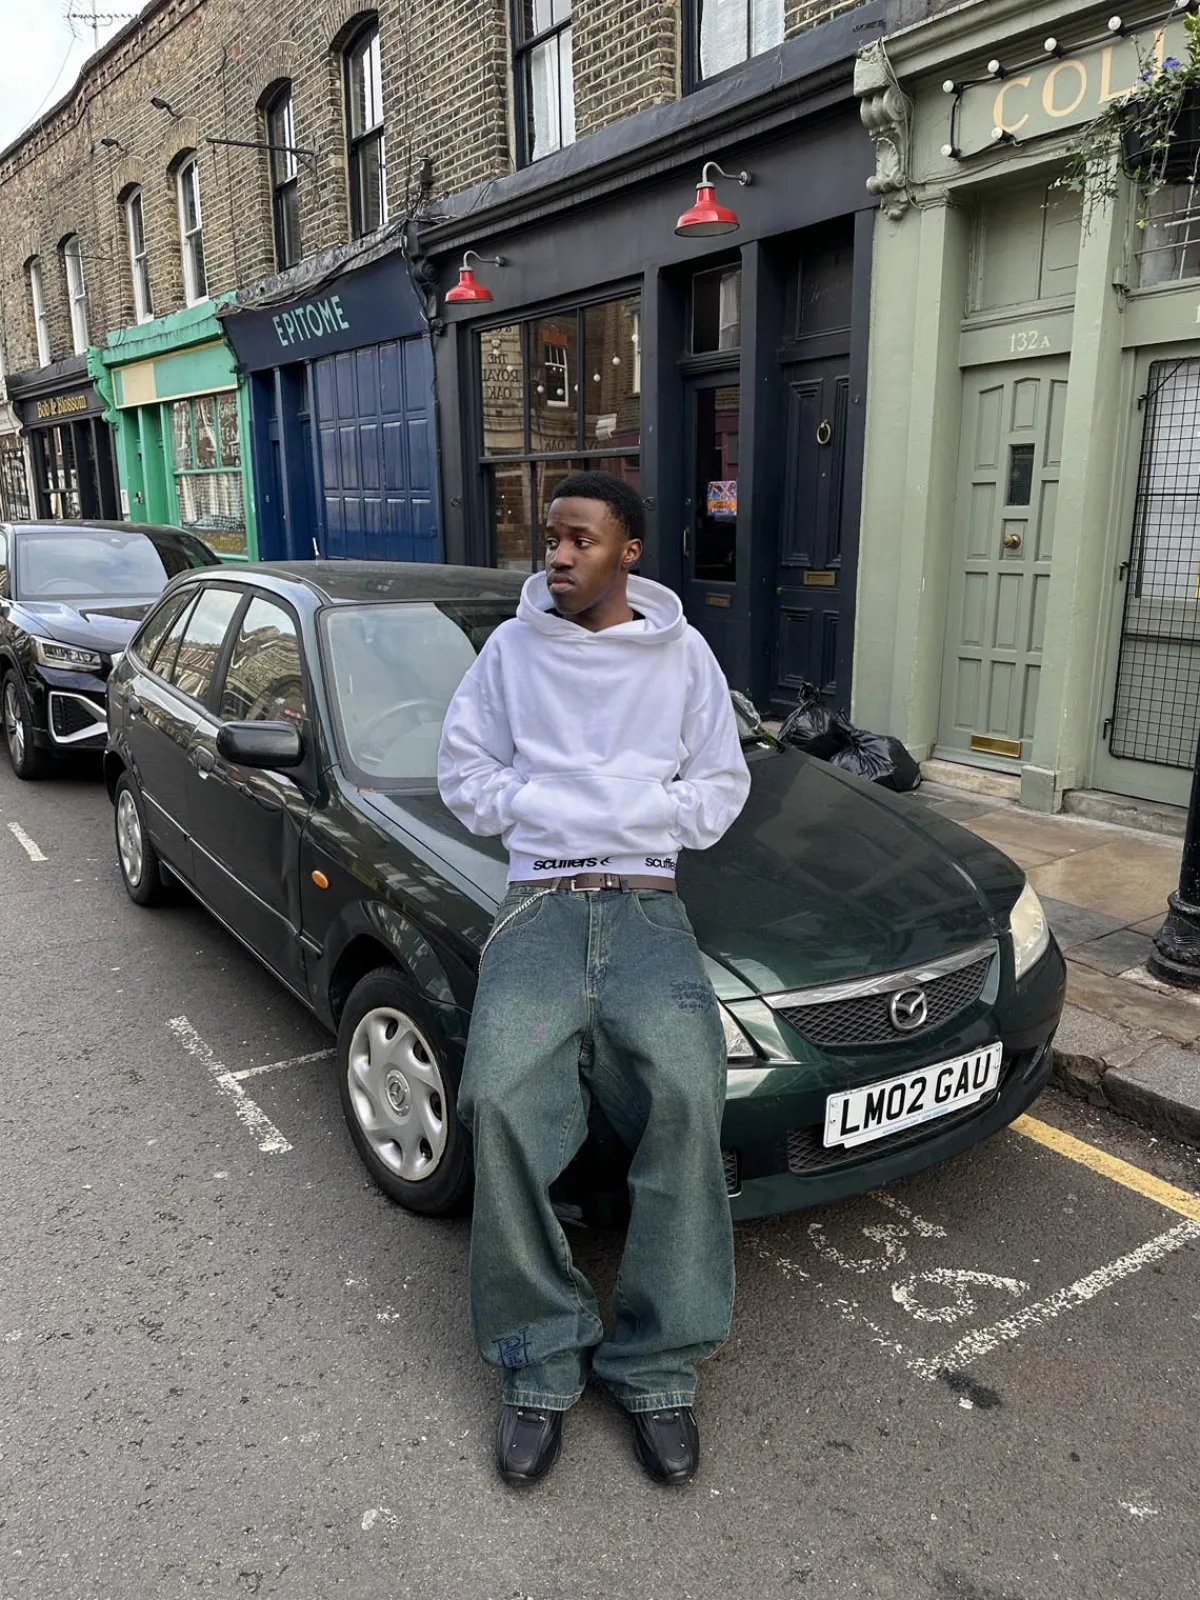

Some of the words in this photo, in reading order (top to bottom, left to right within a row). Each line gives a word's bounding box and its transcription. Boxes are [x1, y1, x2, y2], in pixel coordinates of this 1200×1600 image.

[272, 295, 350, 346] EPITOME
[1009, 330, 1050, 352] 132A
[37, 400, 50, 418] Bob
[57, 395, 87, 414] Blossom
[934, 1053, 992, 1103] GAU
